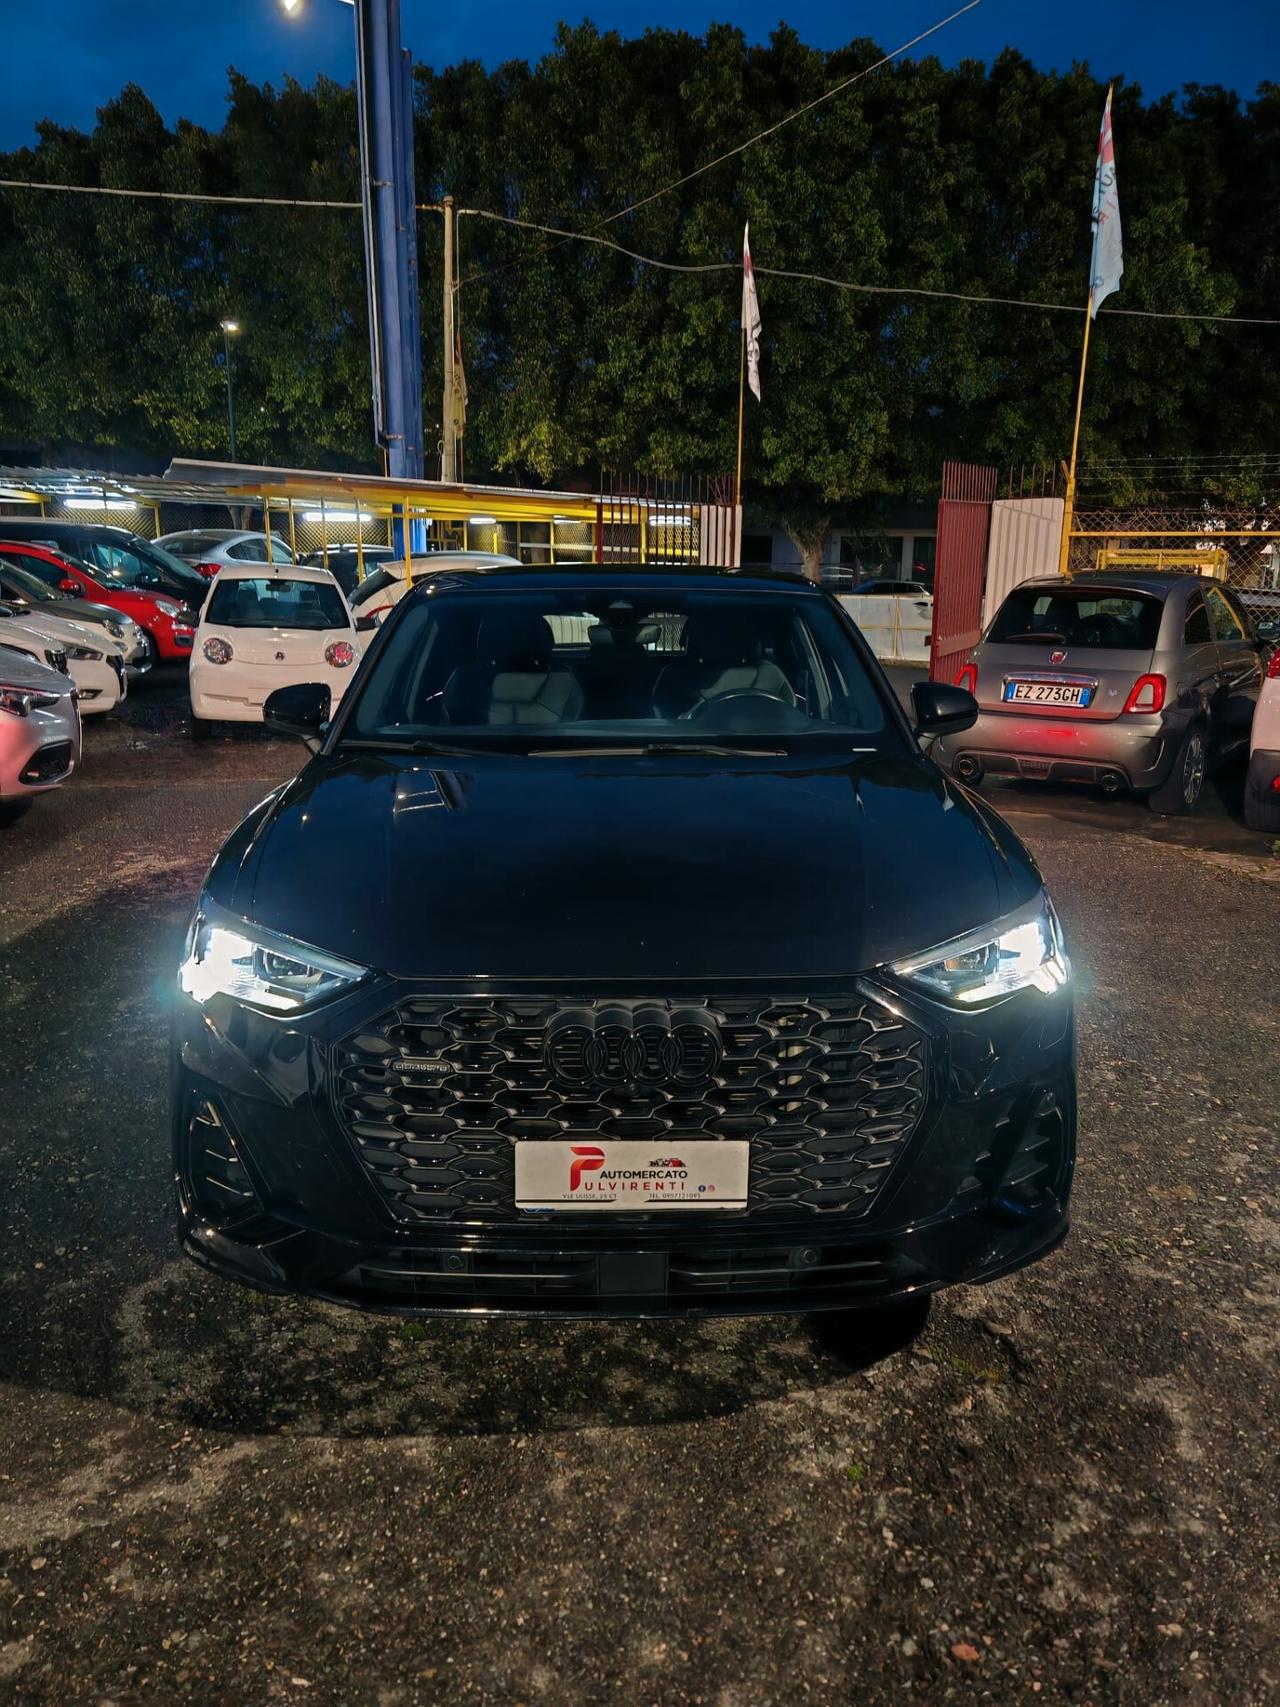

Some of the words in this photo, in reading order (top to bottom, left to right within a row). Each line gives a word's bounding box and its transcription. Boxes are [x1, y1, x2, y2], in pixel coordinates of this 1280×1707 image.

[1015, 685, 1033, 699] EZ
[1036, 686, 1081, 702] 273GH
[599, 1169, 688, 1180] AUTOMERCATO
